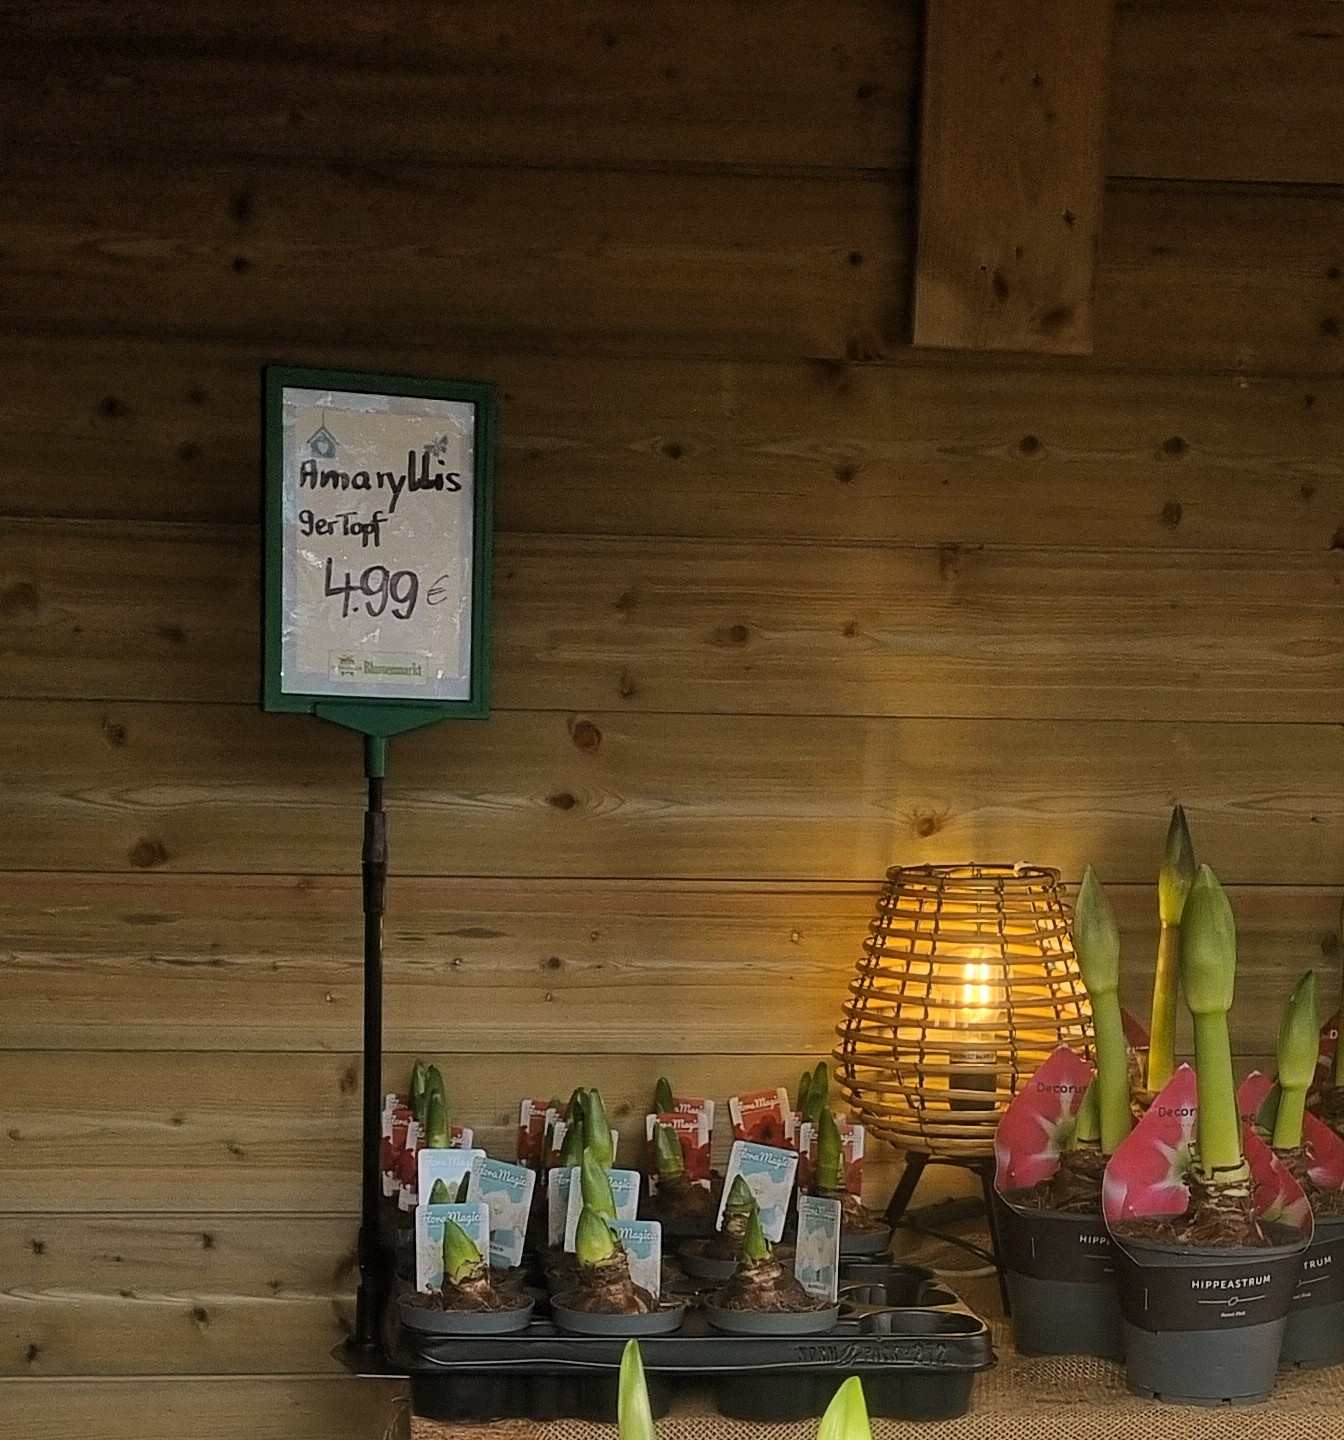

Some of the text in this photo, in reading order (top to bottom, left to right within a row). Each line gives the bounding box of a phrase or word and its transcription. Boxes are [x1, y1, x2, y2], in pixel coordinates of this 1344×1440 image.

[299, 450, 462, 513] Amaryllis
[1036, 1082, 1089, 1094] Decoru
[1158, 1106, 1195, 1118] Decor
[1191, 1274, 1271, 1290] HIPPEASTRUM
